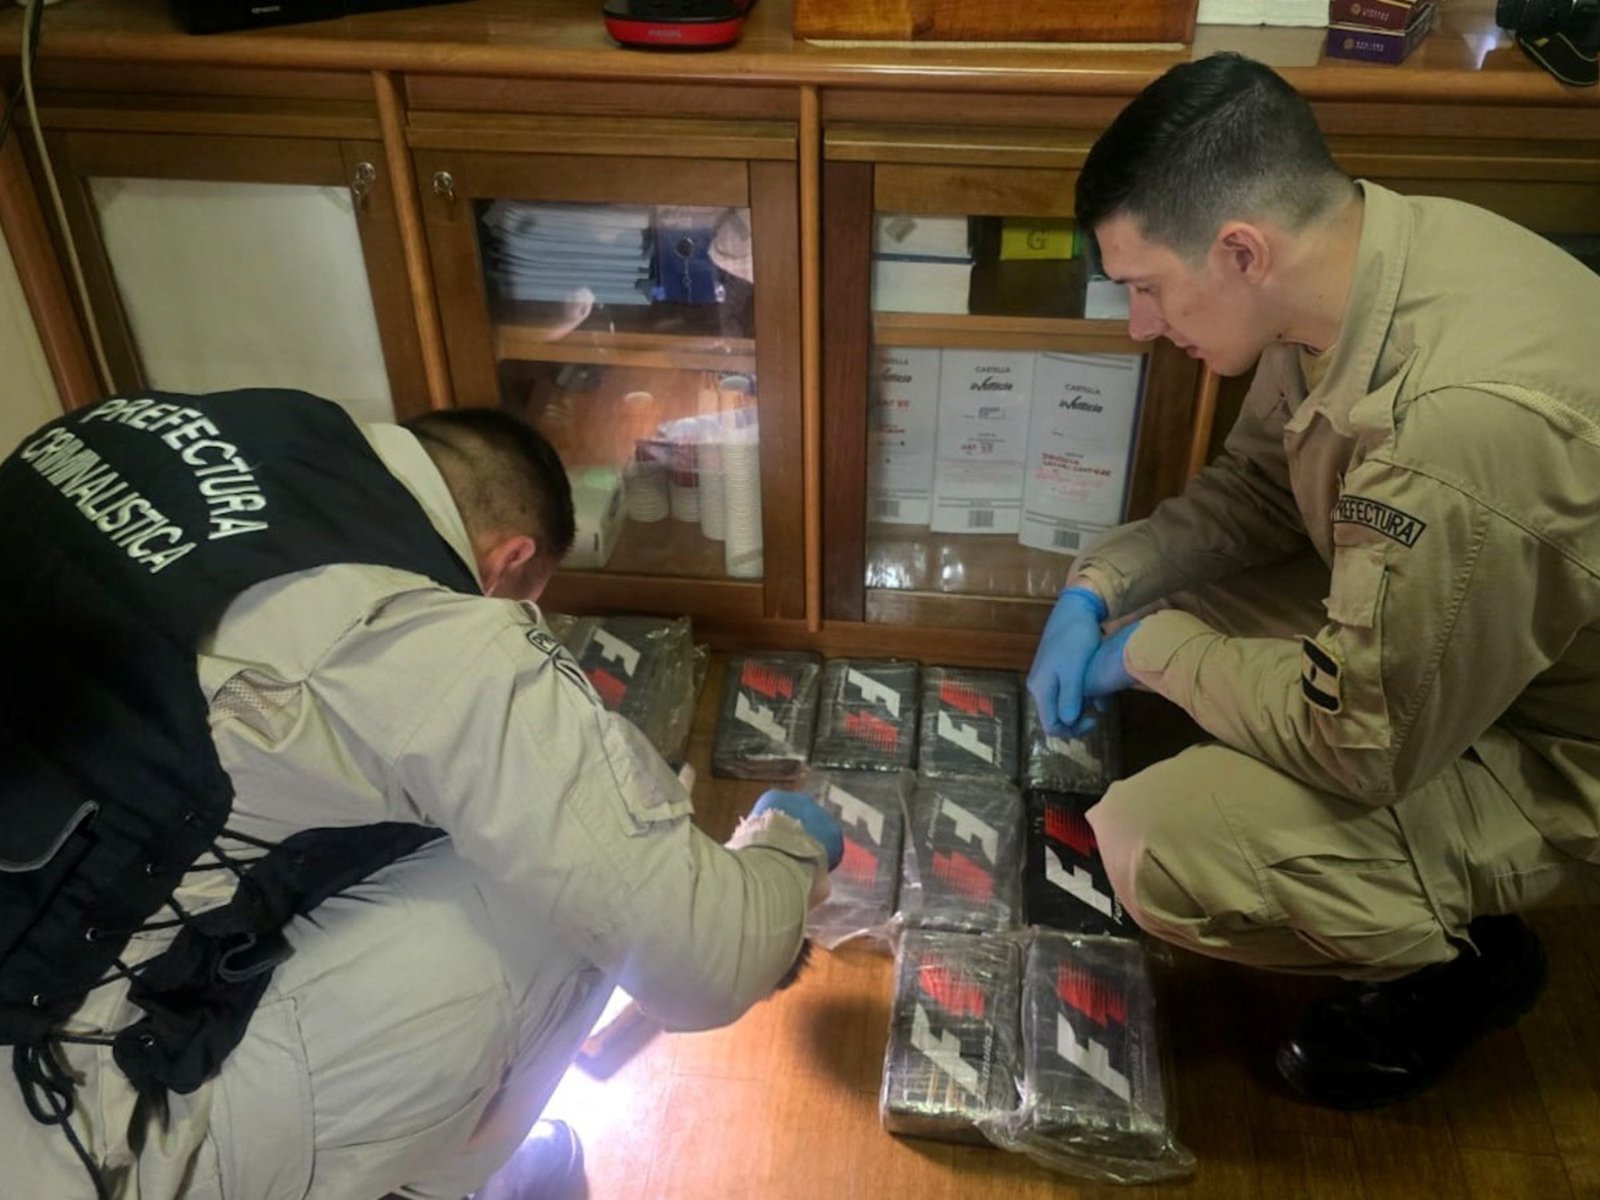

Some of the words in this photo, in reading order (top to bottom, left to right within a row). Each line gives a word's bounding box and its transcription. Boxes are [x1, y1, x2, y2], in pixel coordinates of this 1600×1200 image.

[20, 426, 198, 574] CRIMINALISTICA
[79, 398, 269, 540] PREFECTURA
[1332, 499, 1415, 543] REFECTURA
